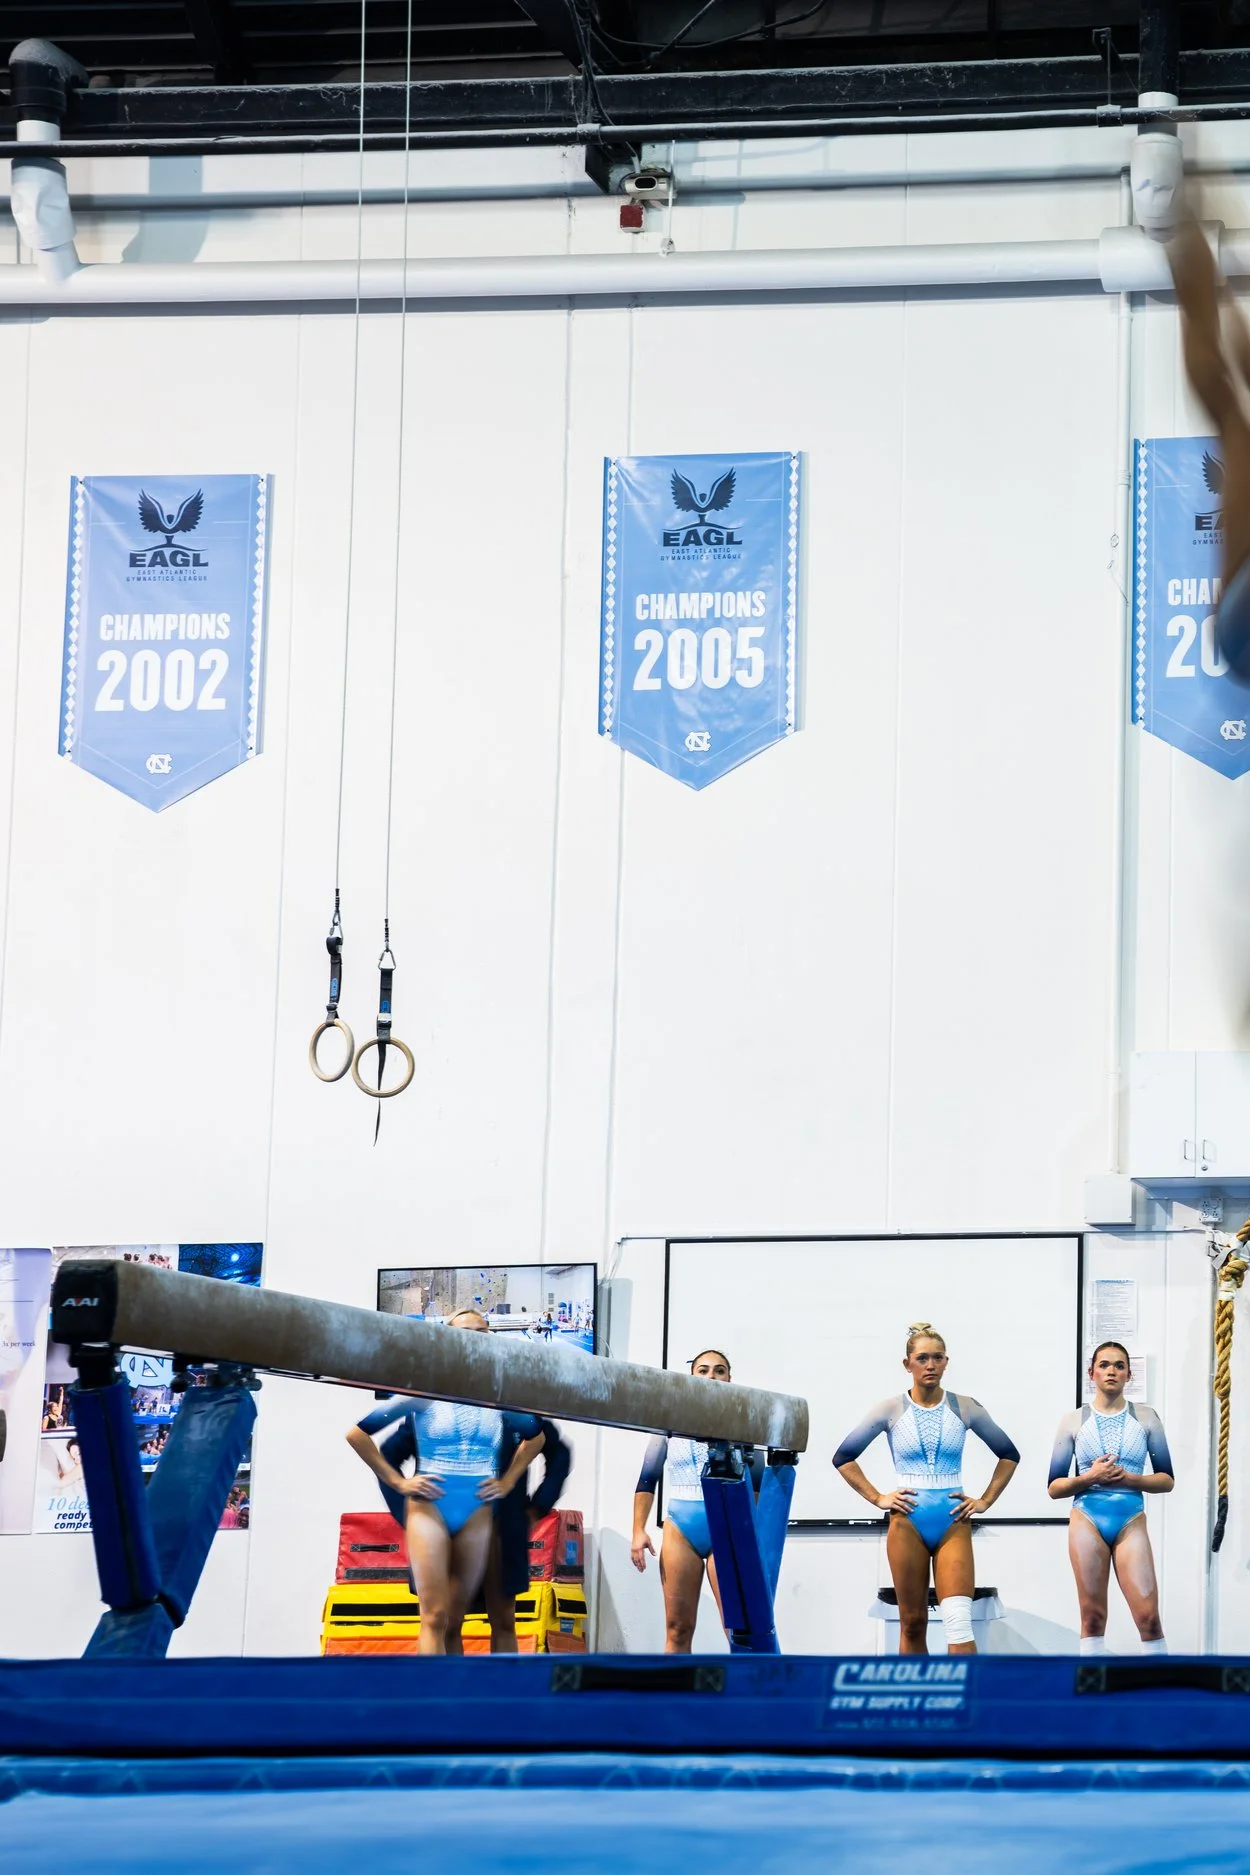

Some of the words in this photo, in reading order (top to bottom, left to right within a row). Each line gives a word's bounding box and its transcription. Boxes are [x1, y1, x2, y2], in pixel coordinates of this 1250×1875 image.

[662, 529, 742, 547] EAGL
[129, 550, 209, 568] EAGL
[635, 590, 766, 621] CHAMPIONS
[99, 613, 230, 641] CHAMPIONS
[1165, 614, 1231, 678] 20
[632, 626, 765, 691] 2005
[94, 648, 229, 711] 2002
[47, 1496, 67, 1511] 10
[54, 1521, 94, 1531] compe
[56, 1510, 88, 1522] ready
